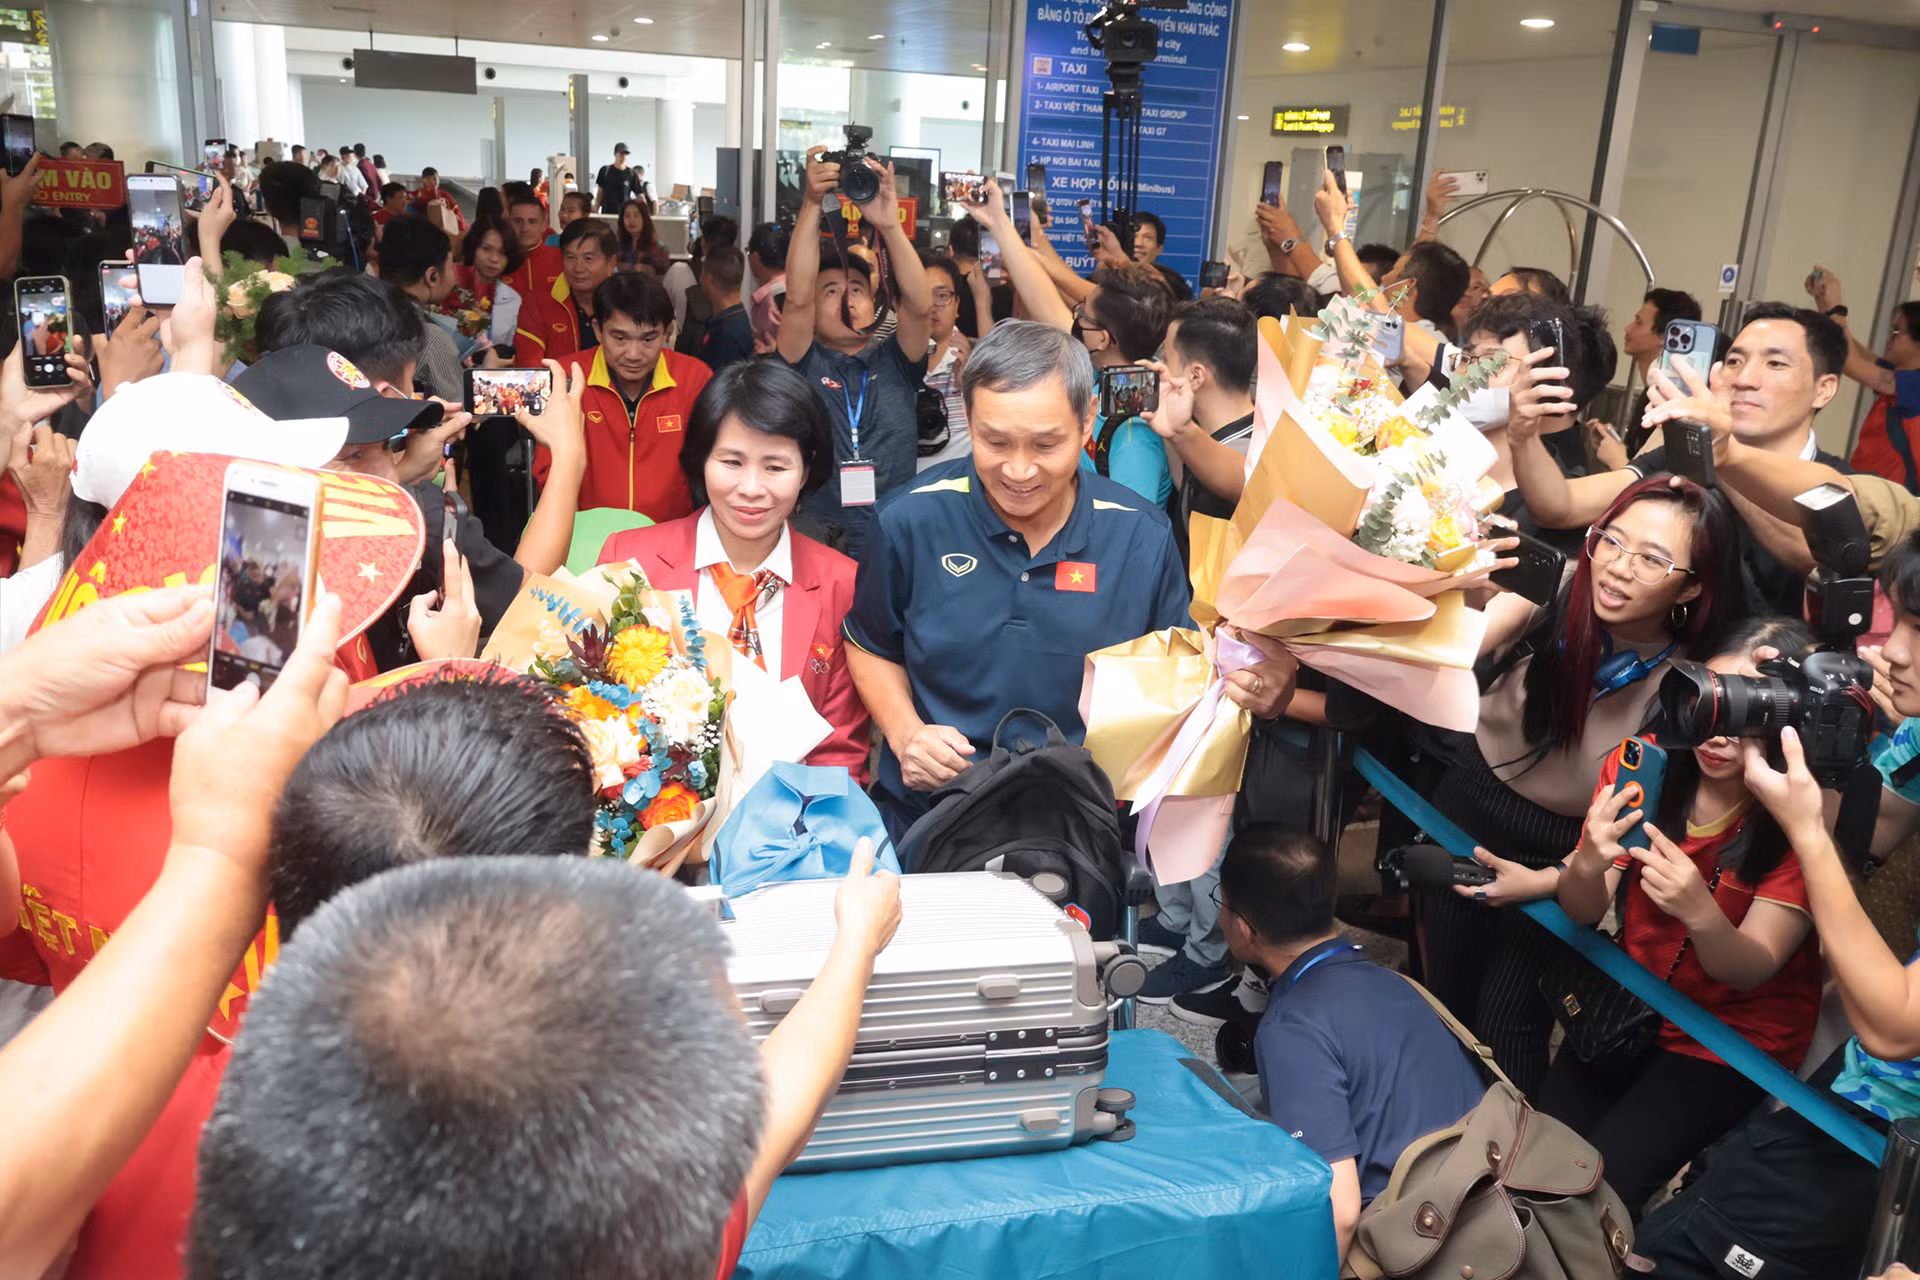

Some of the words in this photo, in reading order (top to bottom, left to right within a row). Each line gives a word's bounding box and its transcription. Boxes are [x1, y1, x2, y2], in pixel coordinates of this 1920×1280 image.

[1063, 7, 1071, 23] Ô
[1072, 8, 1084, 24] TÔ
[1204, 2, 1227, 18] CỘNG
[1177, 21, 1197, 34] KHAI
[1198, 22, 1219, 37] THÁC
[1070, 46, 1089, 55] and
[1164, 39, 1182, 51] city
[1060, 62, 1087, 75] TAXI
[1044, 83, 1080, 93] AIRPORT
[1081, 85, 1099, 94] TAXI
[1043, 101, 1062, 110] TAXI
[1063, 100, 1080, 113] VIỆT
[1082, 104, 1104, 113] THAN
[1141, 108, 1159, 117] TAXI
[1160, 110, 1187, 119] GROUP
[1041, 137, 1059, 147] TAXI
[1060, 139, 1075, 148] MAI
[1076, 140, 1095, 149] LINH
[1083, 159, 1100, 168] TAXI
[65, 167, 112, 190] VÀO
[1052, 177, 1068, 188] XE
[1071, 177, 1096, 191] HỢP
[52, 191, 91, 202] ENTRY
